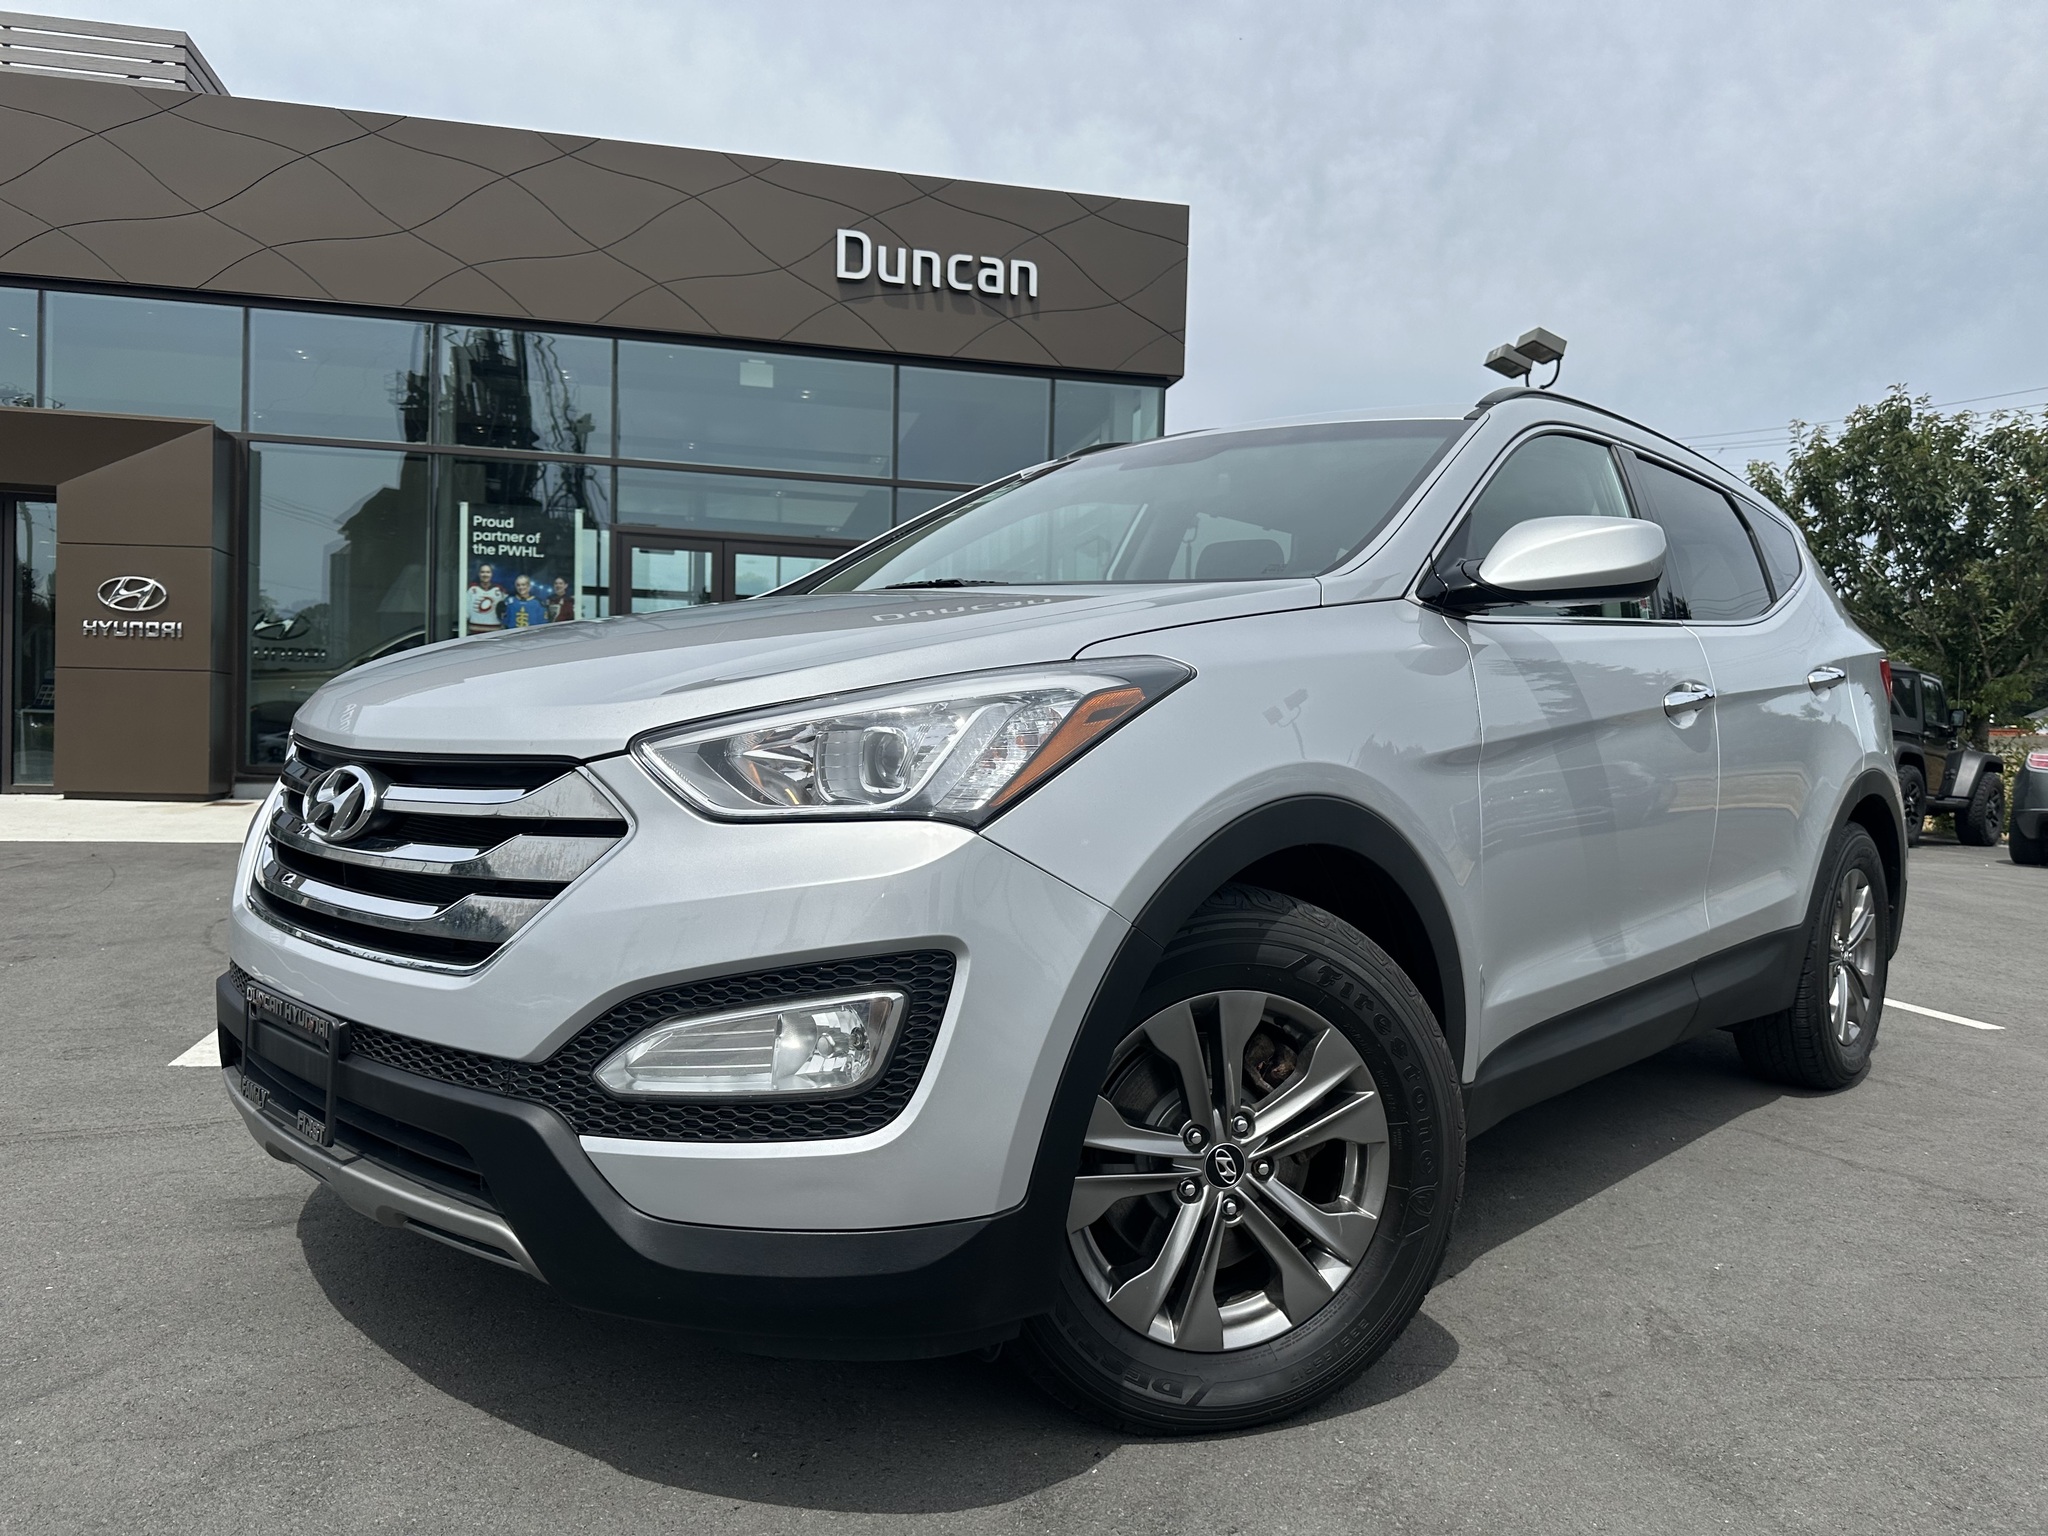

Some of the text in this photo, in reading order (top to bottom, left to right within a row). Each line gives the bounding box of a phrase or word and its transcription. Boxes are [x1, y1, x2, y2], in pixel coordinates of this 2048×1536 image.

[836, 228, 1038, 298] Duncan
[472, 515, 514, 529] Proud
[472, 531, 541, 544] partner of
[472, 543, 545, 558] the PWHL.
[82, 619, 183, 639] HYUNDAI
[1316, 964, 1436, 1176] Firestone
[296, 1110, 325, 1145] FIRST
